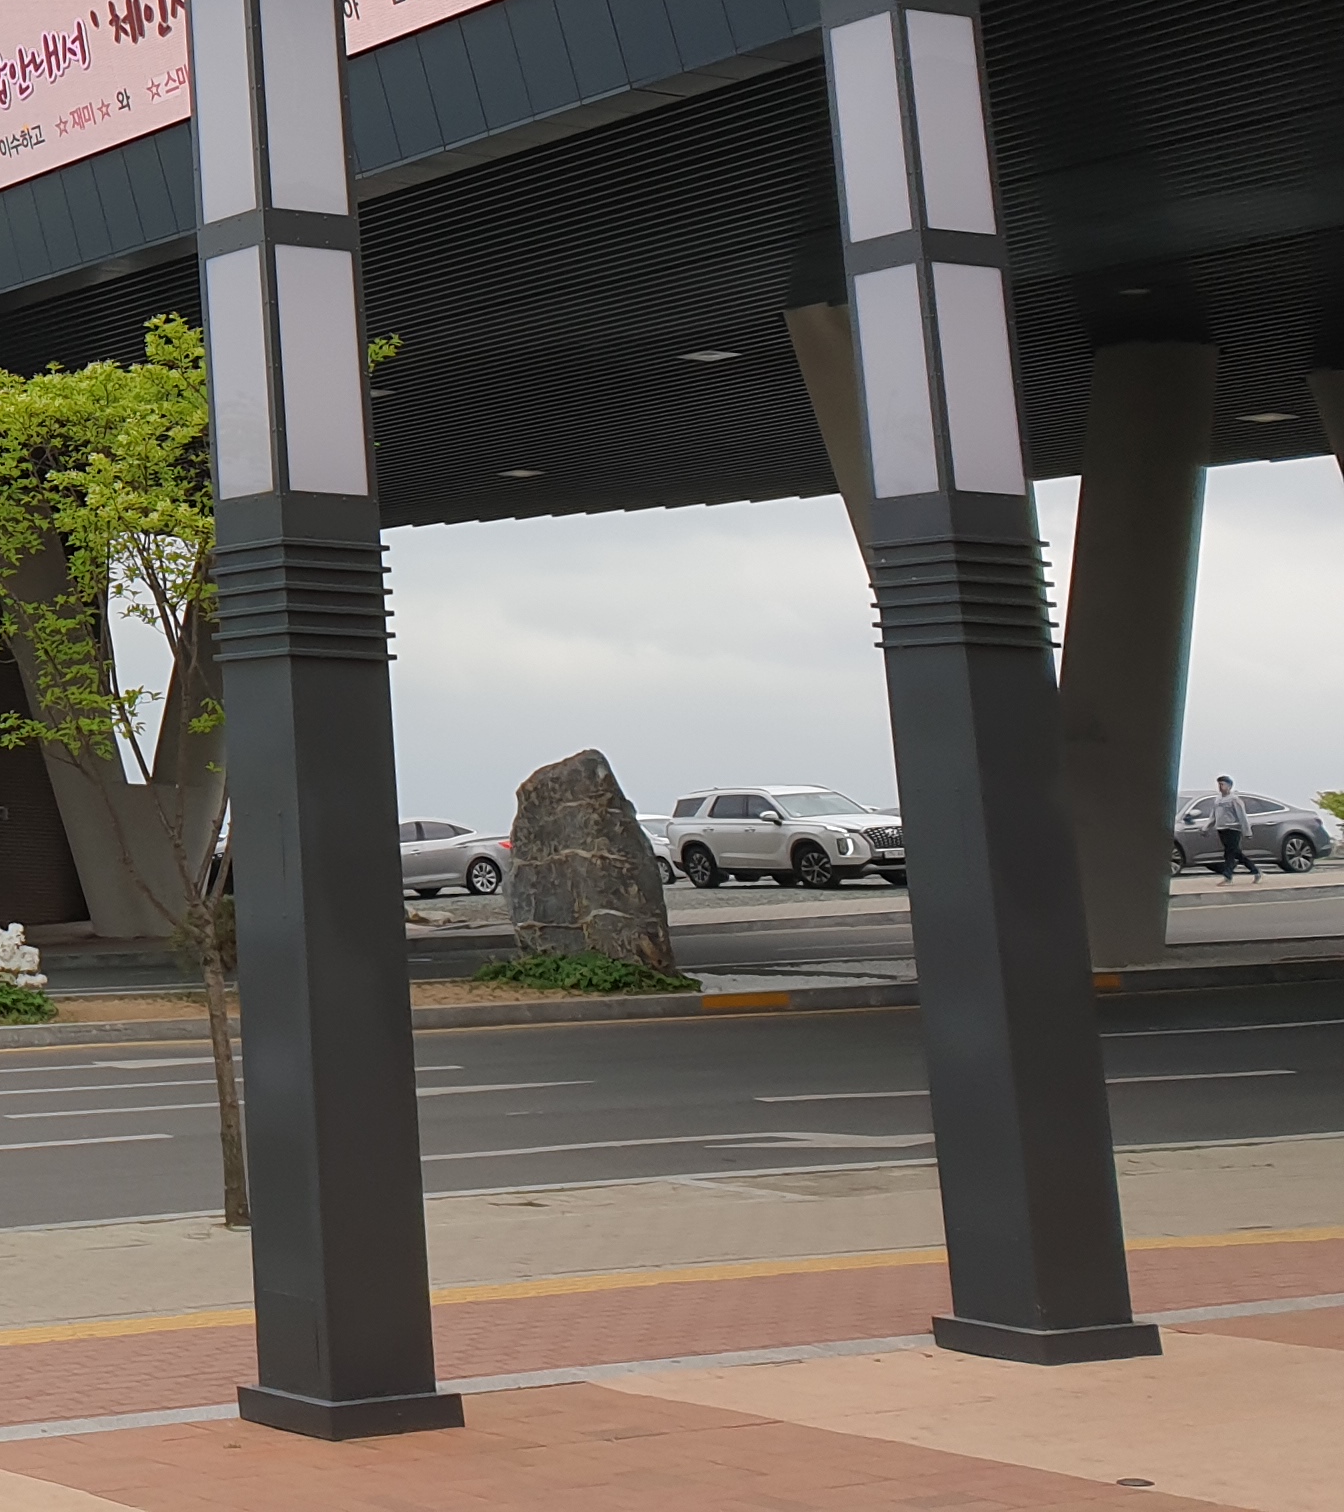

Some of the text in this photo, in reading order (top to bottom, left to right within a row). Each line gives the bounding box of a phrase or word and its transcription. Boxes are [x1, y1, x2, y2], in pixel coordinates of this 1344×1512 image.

[0, 124, 46, 159] 이수하고
[69, 101, 97, 131] 재미
[115, 87, 132, 112] 와
